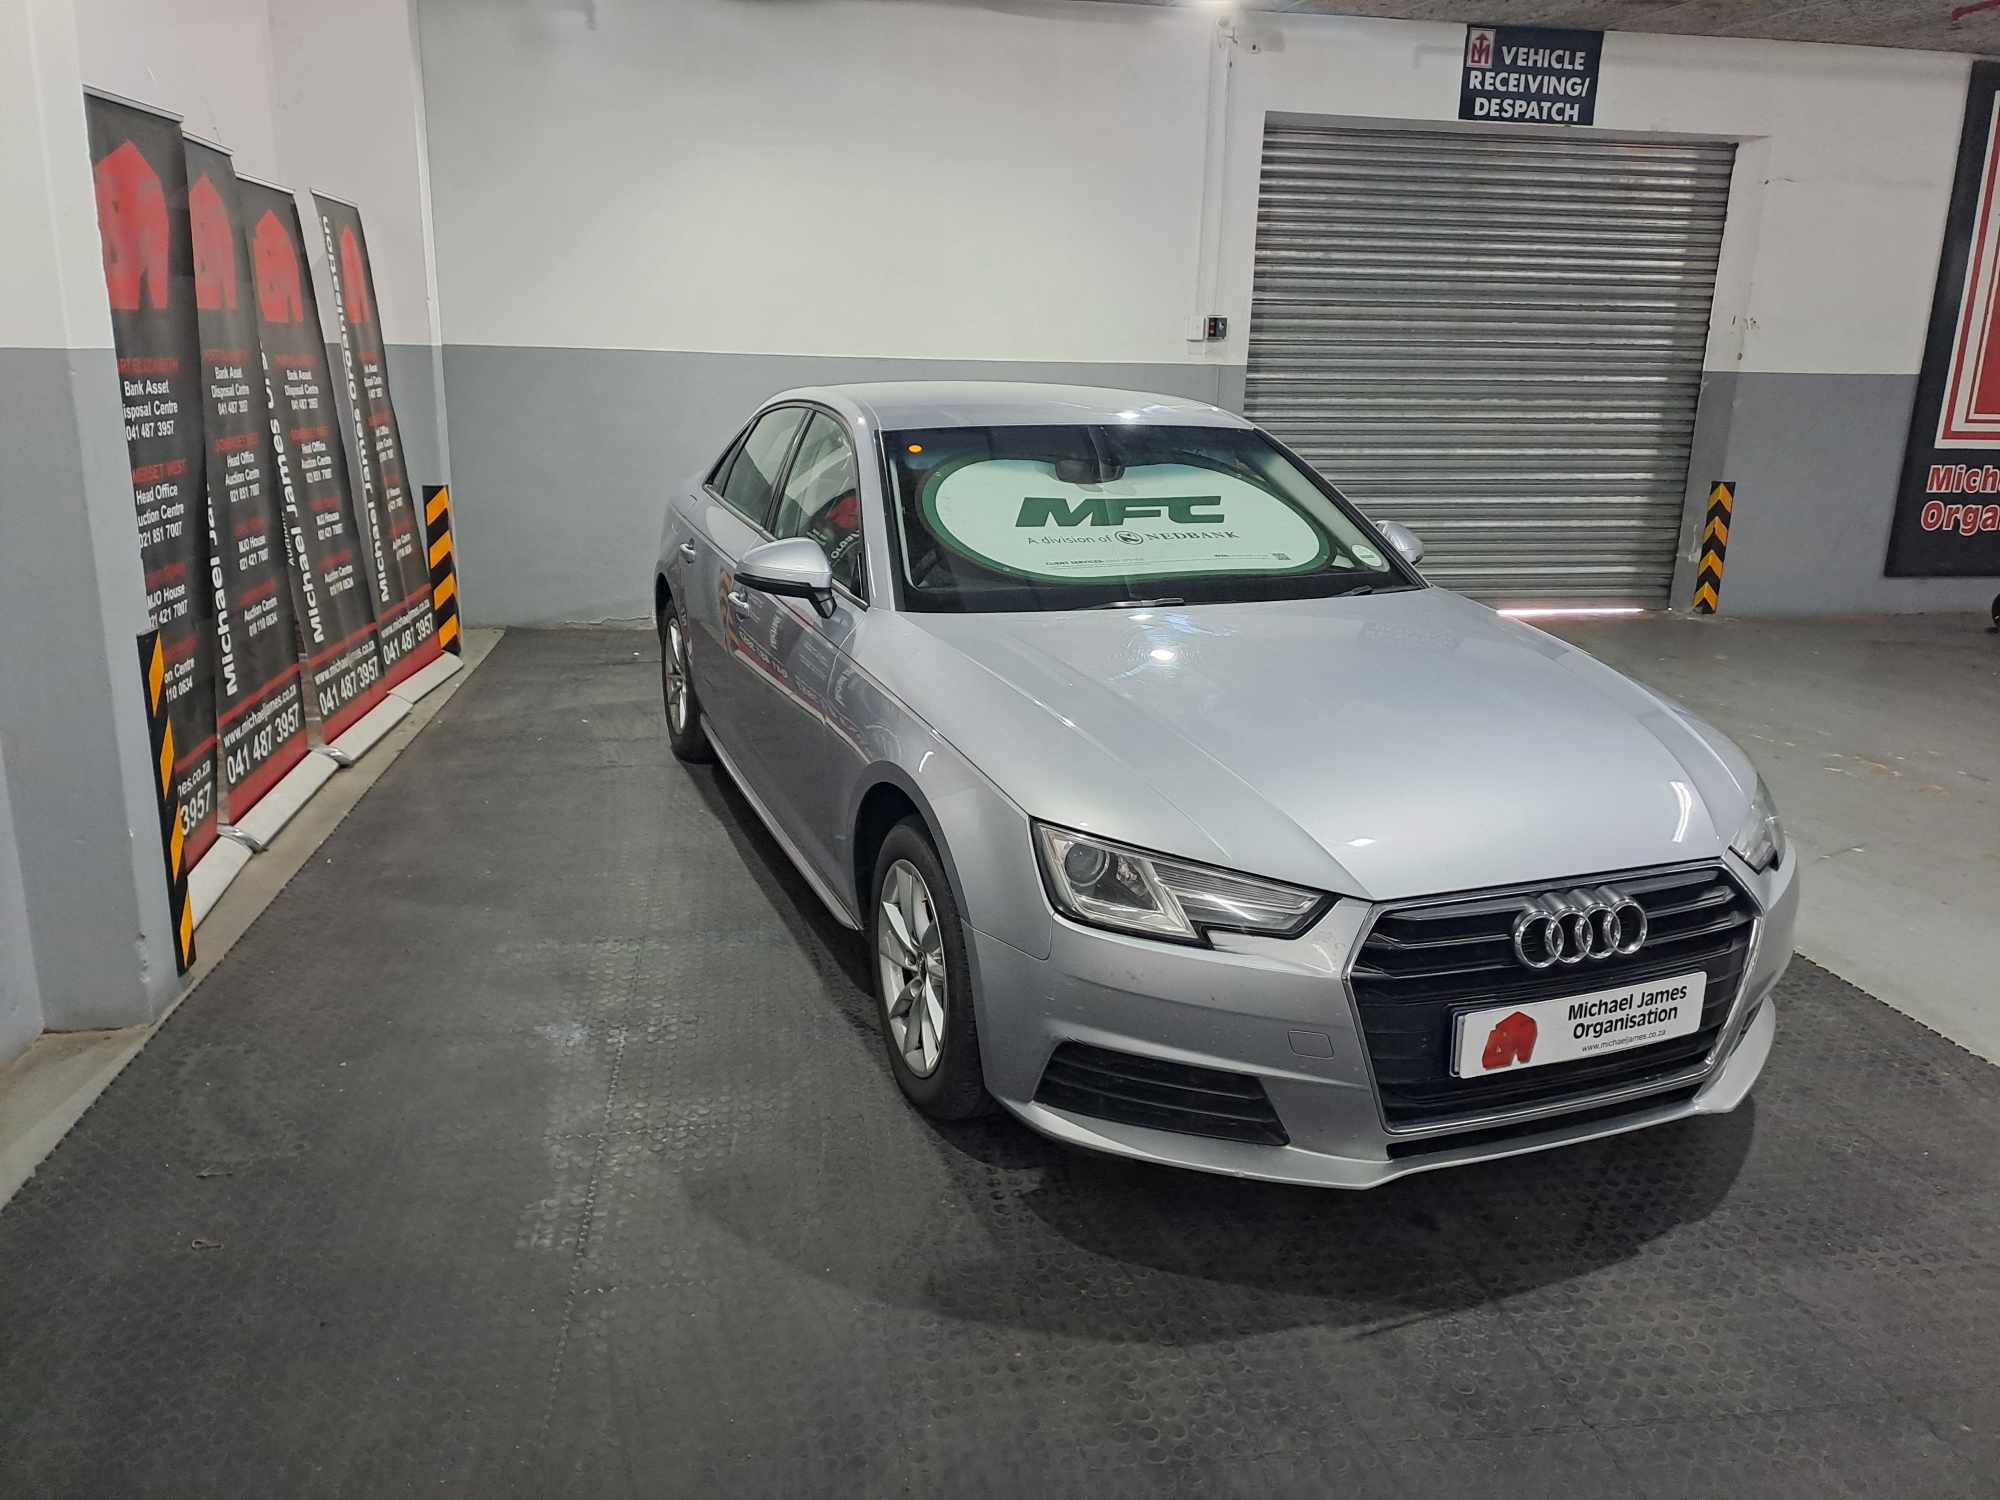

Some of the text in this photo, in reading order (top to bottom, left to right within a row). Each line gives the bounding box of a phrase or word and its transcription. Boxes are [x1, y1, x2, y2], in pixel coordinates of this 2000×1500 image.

[1502, 46, 1586, 70] VEHICLE
[1469, 70, 1590, 97] RECEIVING/
[1474, 97, 1580, 122] DESPATCH
[123, 379, 170, 396] Bank Asset
[122, 400, 179, 421] isposal Centre
[126, 420, 175, 441] 041 487 3957
[1926, 464, 2000, 493] Mich
[136, 483, 178, 505] Head Office
[137, 502, 185, 527] uction Centre
[1015, 495, 1225, 528] MFC
[1921, 500, 2000, 536] Orga
[270, 418, 325, 643] Michael James
[1027, 530, 1240, 545] A division of NEDBANK
[367, 501, 390, 602] Michael
[163, 583, 185, 602] House
[209, 556, 238, 697] Michael
[383, 637, 400, 665] 041
[415, 612, 433, 641] 3957
[319, 655, 380, 716] 041 487 3957
[227, 702, 299, 785] 041 487 3957
[180, 781, 212, 836] 3957
[1568, 985, 1688, 1021] Michael James
[1573, 1006, 1679, 1039] Organisation
[1581, 1029, 1667, 1052] www.michaeljames.co.za
